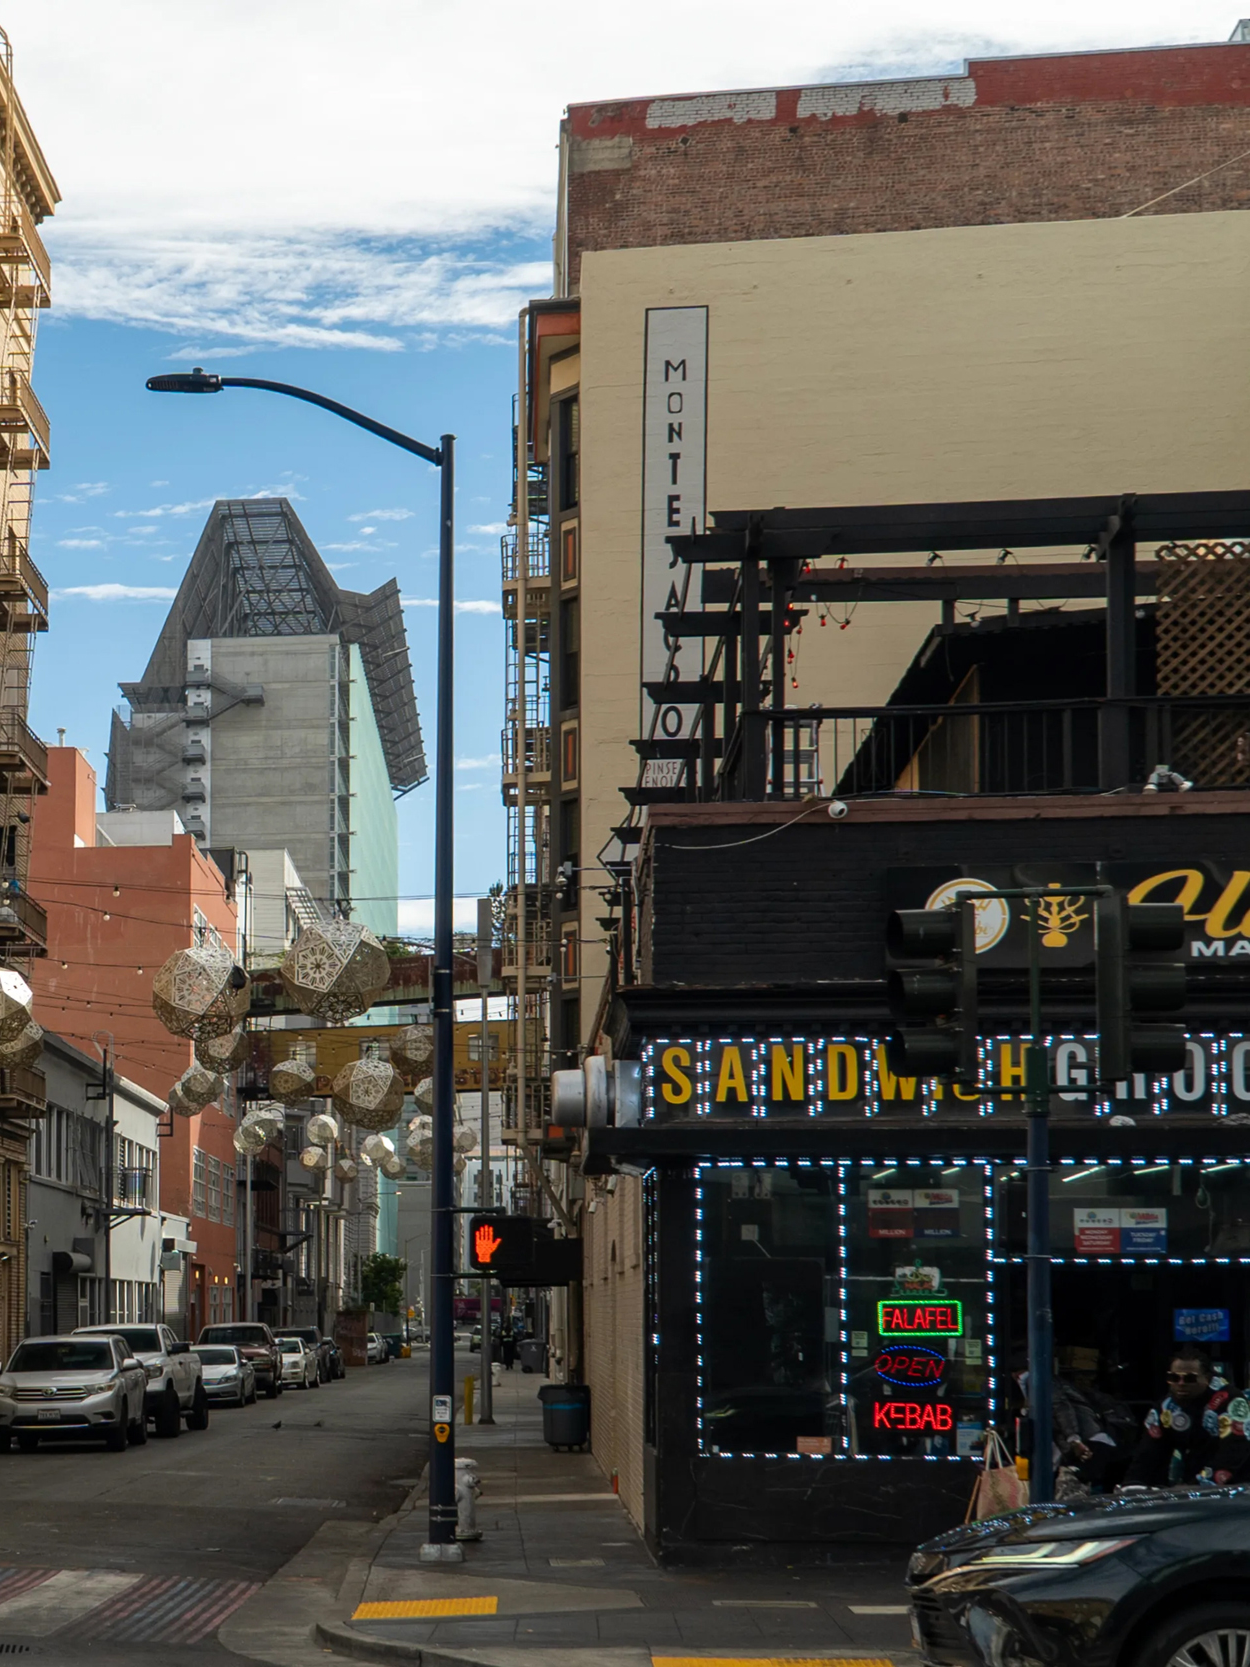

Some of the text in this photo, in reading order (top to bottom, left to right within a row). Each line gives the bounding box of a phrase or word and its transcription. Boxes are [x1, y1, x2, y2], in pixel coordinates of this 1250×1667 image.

[881, 1307, 958, 1329] FALAFEL
[875, 1354, 946, 1379] OPEN
[873, 1401, 953, 1431] KEBAB
